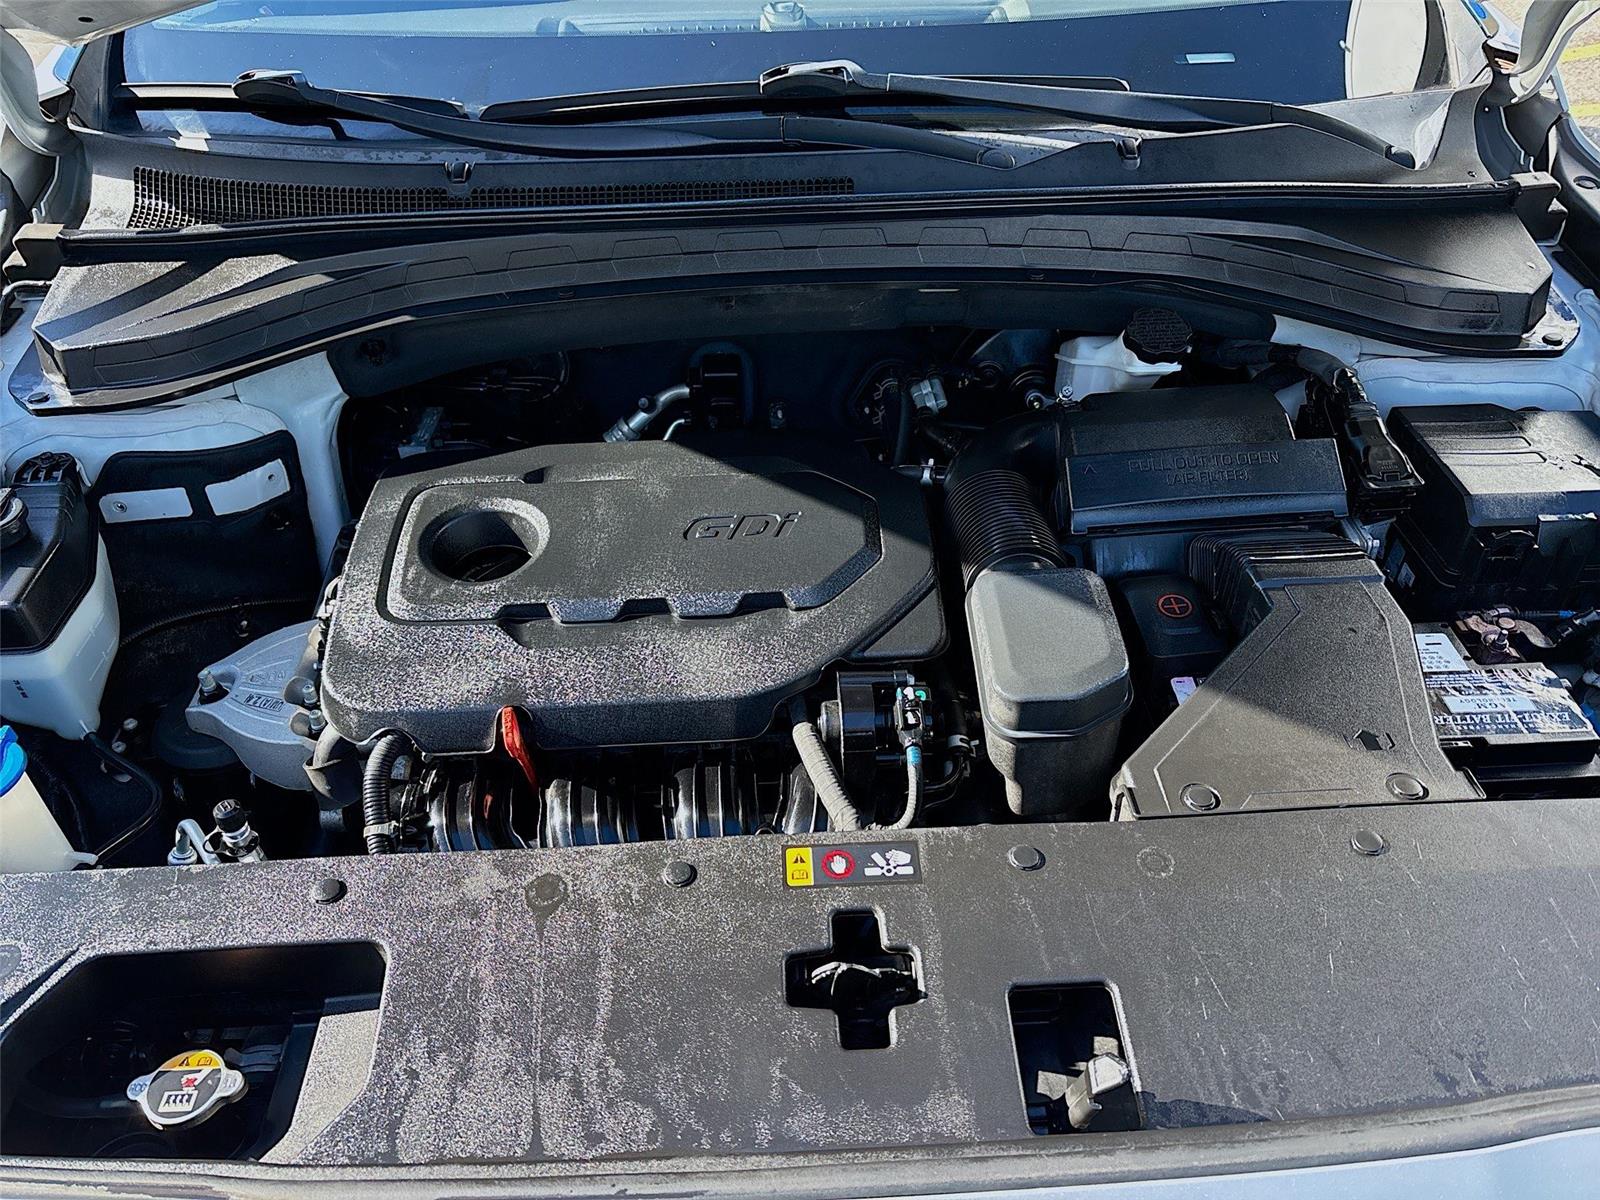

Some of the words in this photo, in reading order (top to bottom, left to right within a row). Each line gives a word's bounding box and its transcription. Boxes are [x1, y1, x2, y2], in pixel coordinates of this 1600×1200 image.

[1128, 458, 1170, 473] PULL
[1174, 455, 1206, 470] OUT
[1211, 453, 1233, 468] TO
[1234, 450, 1280, 466] OPEN
[1166, 472, 1197, 487] (AIR
[1198, 468, 1250, 484] FILTER)
[683, 511, 802, 541] GDi
